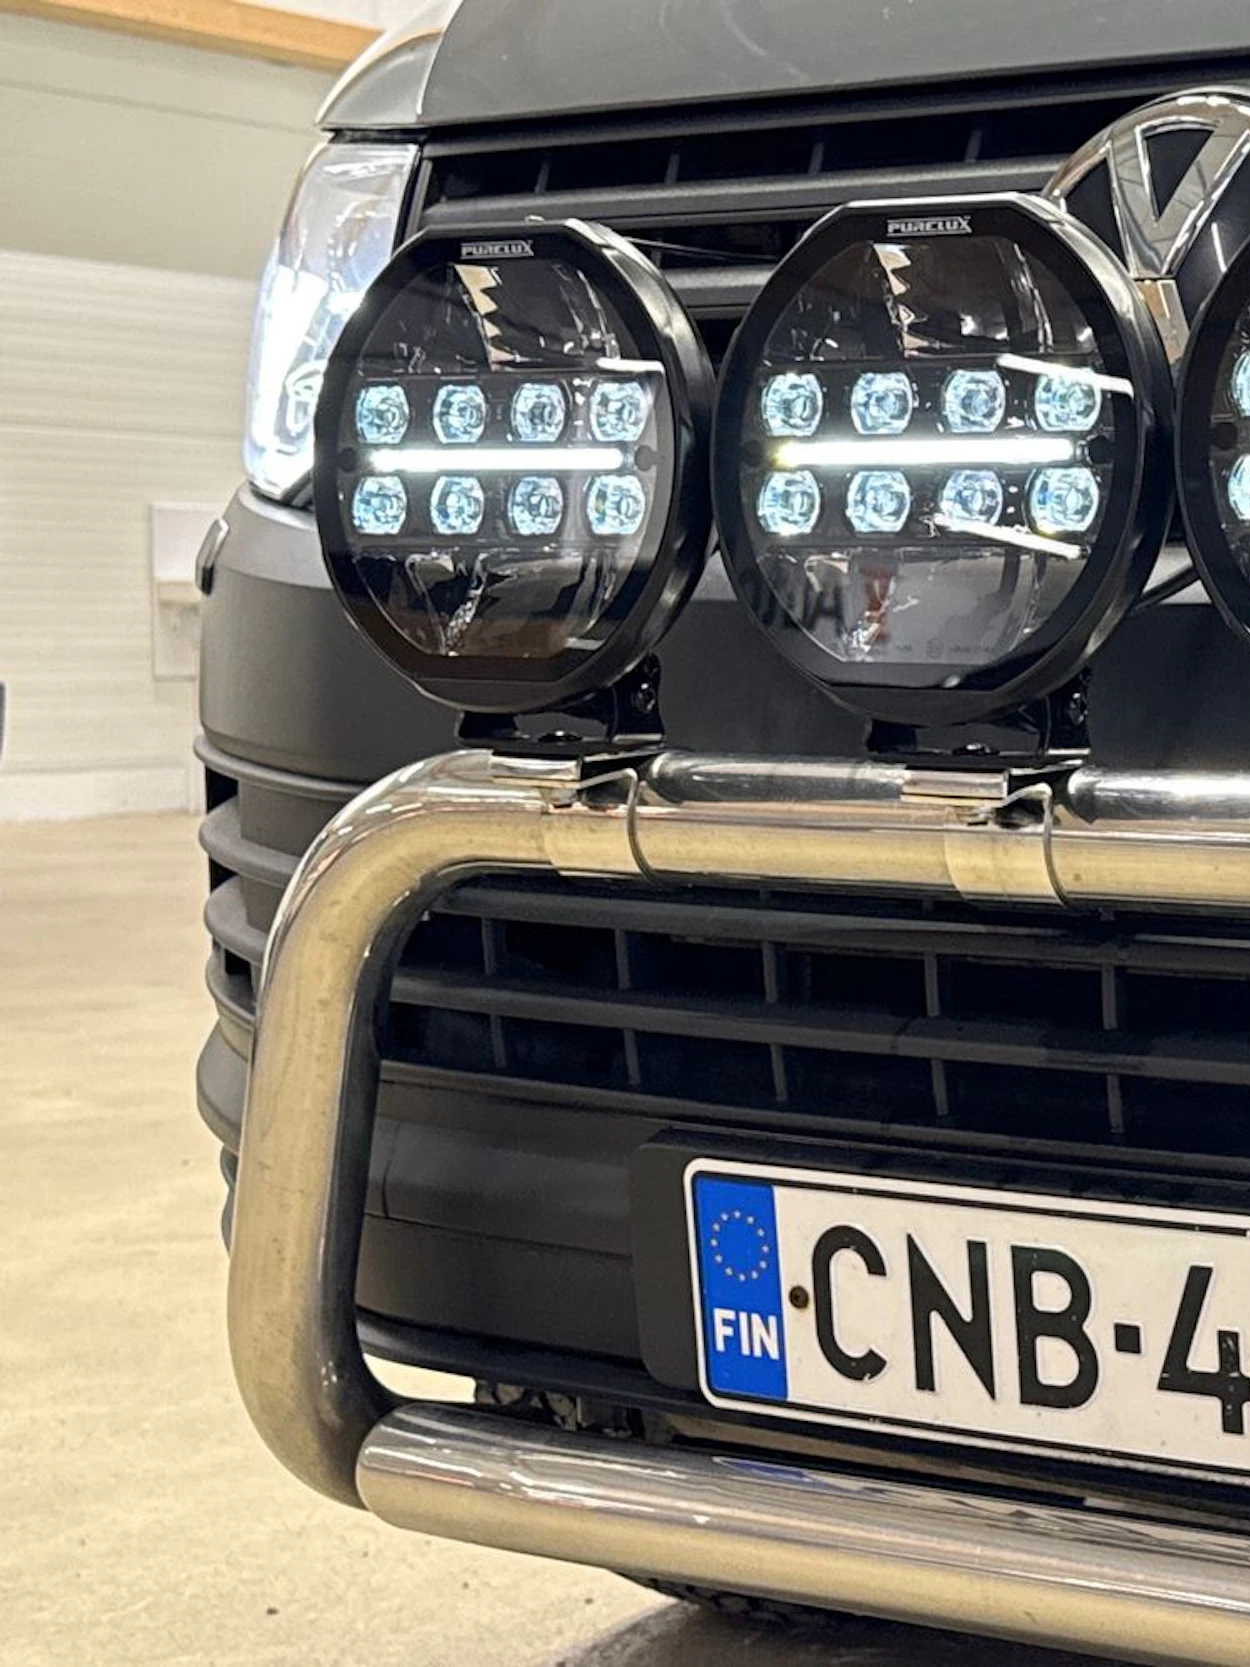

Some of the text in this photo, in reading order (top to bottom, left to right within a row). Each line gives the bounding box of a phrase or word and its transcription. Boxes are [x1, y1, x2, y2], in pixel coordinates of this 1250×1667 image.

[886, 215, 972, 236] PURELUX
[461, 240, 534, 259] PURELUX
[714, 1307, 779, 1361] FIN
